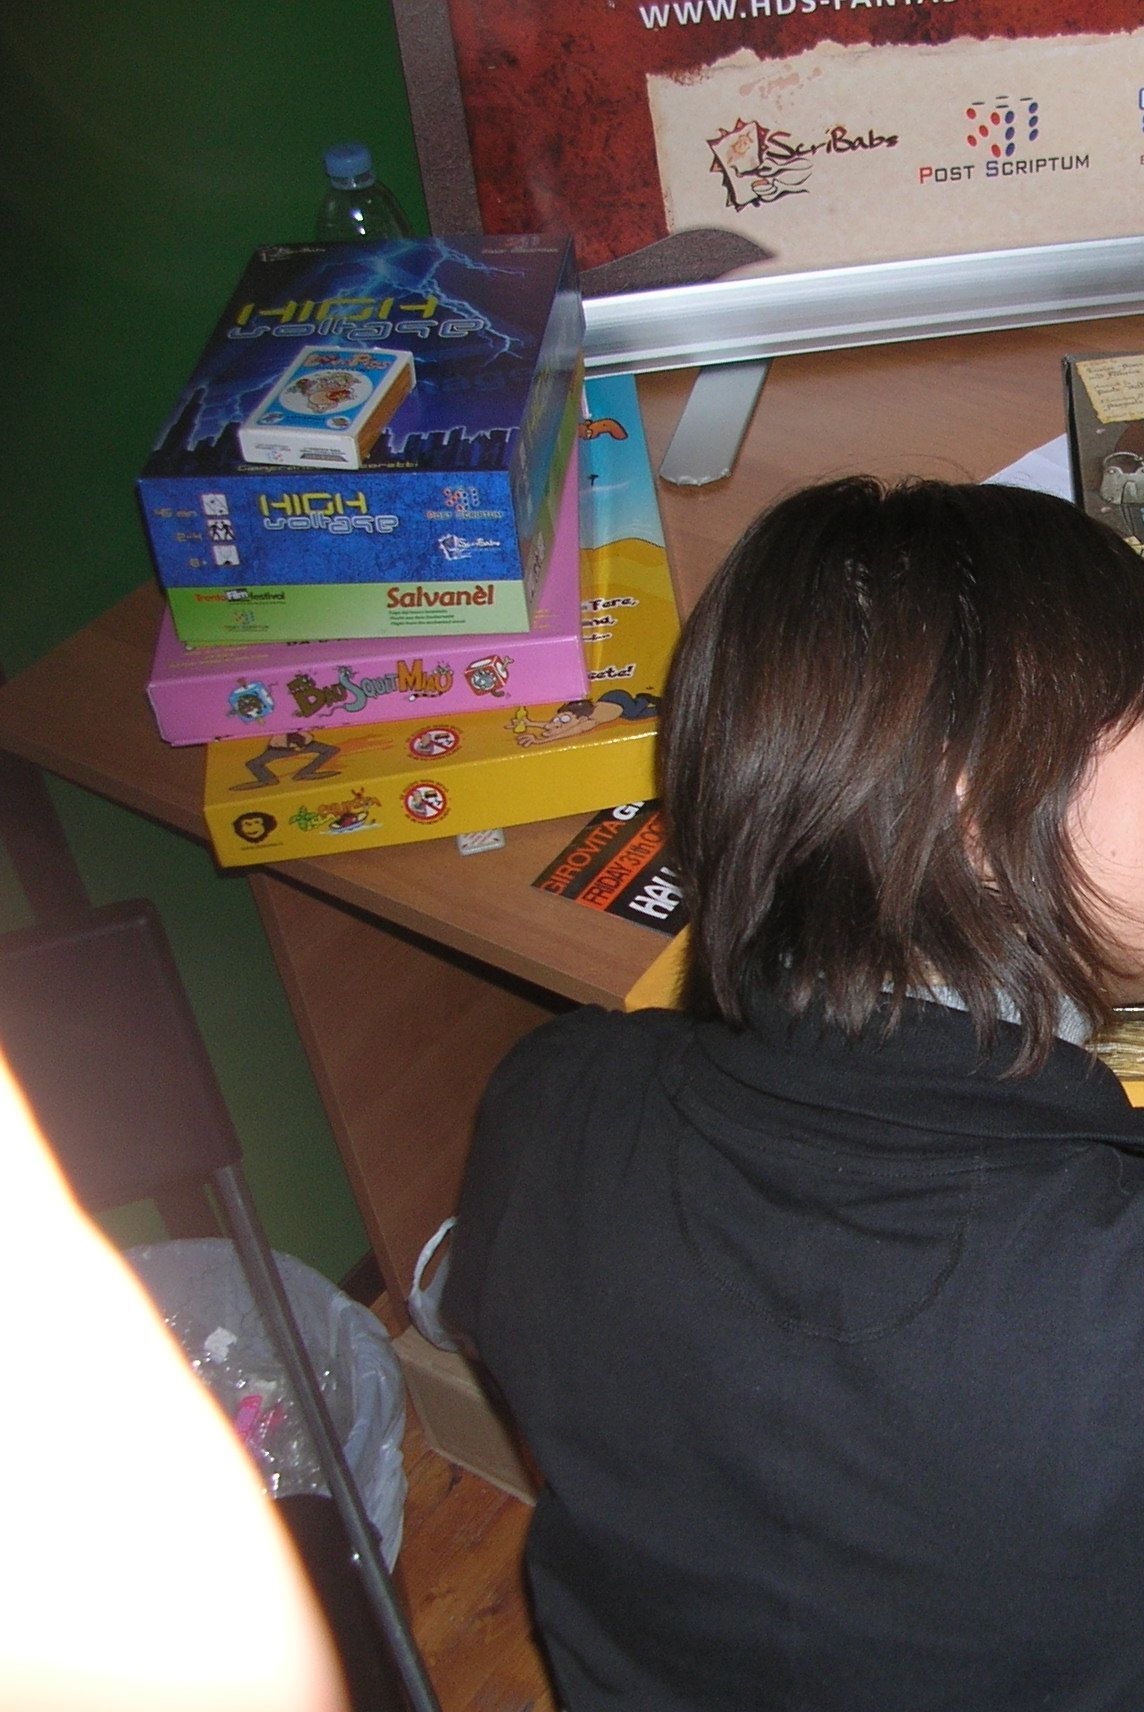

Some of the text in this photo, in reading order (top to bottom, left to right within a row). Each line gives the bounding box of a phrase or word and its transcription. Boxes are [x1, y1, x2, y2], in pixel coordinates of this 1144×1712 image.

[919, 154, 1090, 184] POST SCRIPTUM
[237, 295, 439, 325] HIGH
[259, 492, 367, 517] HIGH
[387, 584, 494, 608] Salvanèl
